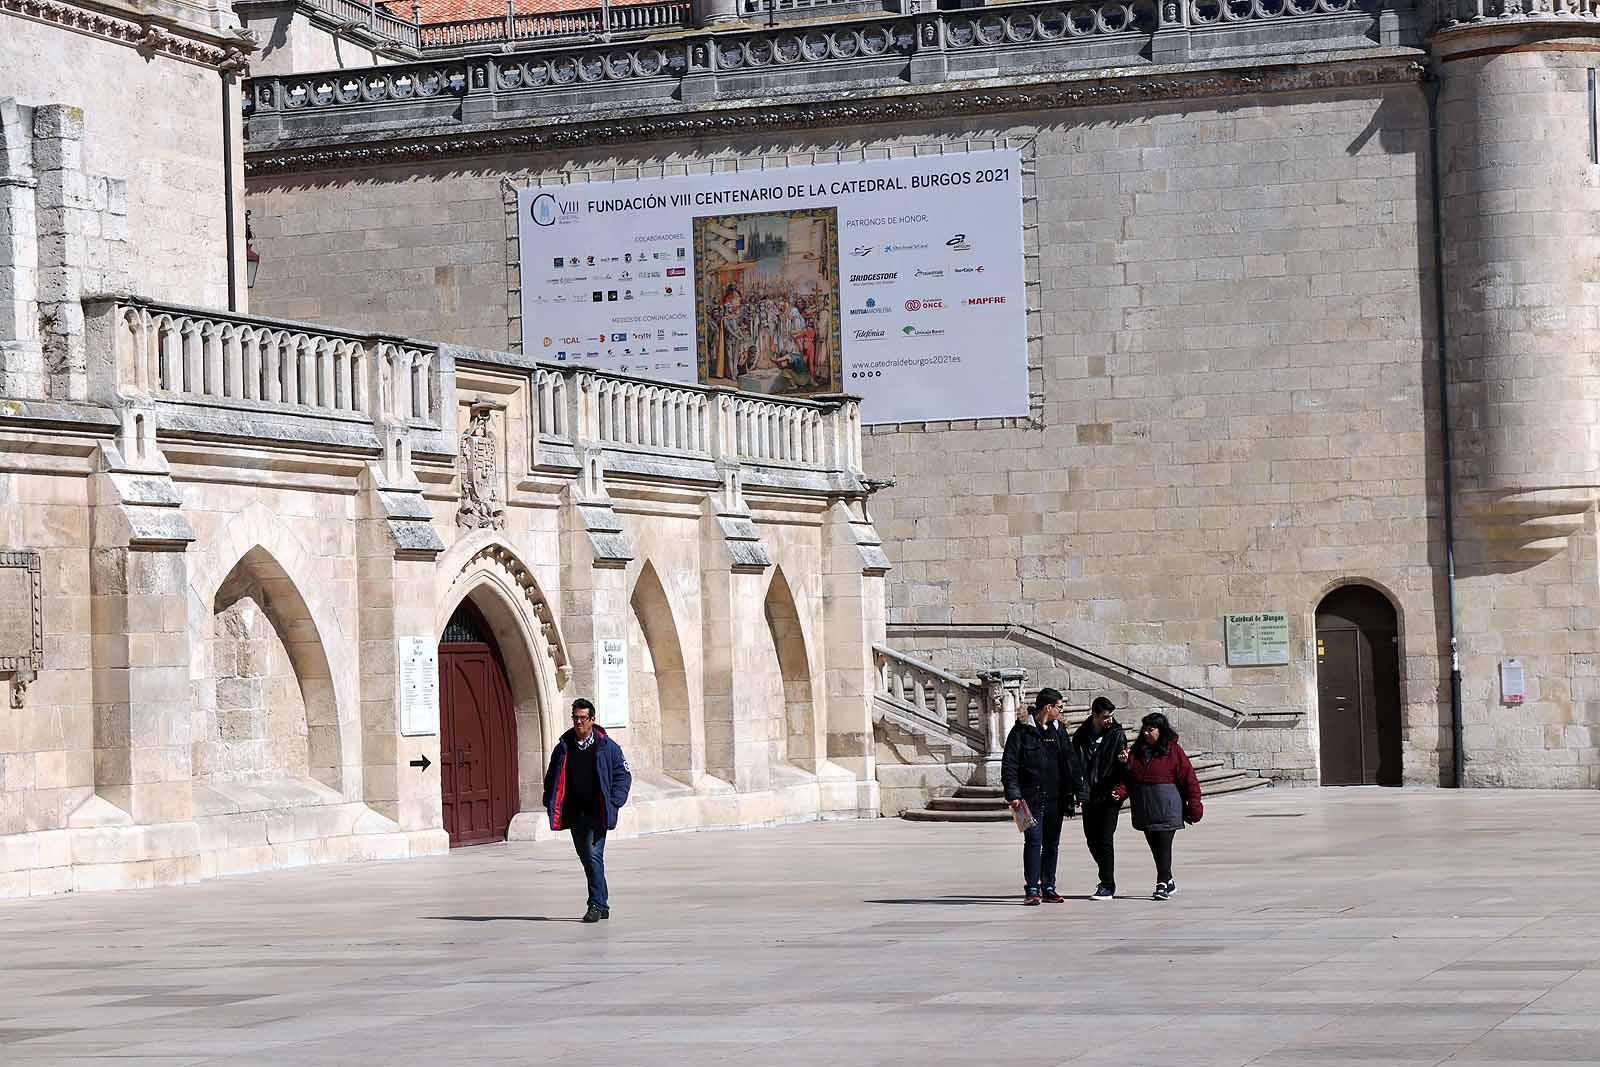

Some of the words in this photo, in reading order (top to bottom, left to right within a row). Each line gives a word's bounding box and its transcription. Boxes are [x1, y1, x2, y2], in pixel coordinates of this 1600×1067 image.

[588, 194, 666, 213] FUNDACIÓN
[671, 194, 691, 208] VIII
[695, 187, 783, 205] CENTENARIO
[788, 185, 804, 198] DE
[809, 183, 826, 196] LA
[831, 178, 907, 194] CATEDRAL.
[912, 172, 971, 188] BURGOS
[975, 169, 1009, 183] 2021
[559, 201, 579, 215] VIII
[846, 216, 886, 228] PATRONOS
[888, 216, 897, 224] DE
[850, 272, 898, 282] BRIDGESTONE
[968, 296, 1006, 305] MAPFRE
[853, 328, 885, 339] Telefónica
[564, 336, 581, 345] ICAL
[852, 355, 961, 370] www.catedraldeburgos2021.es
